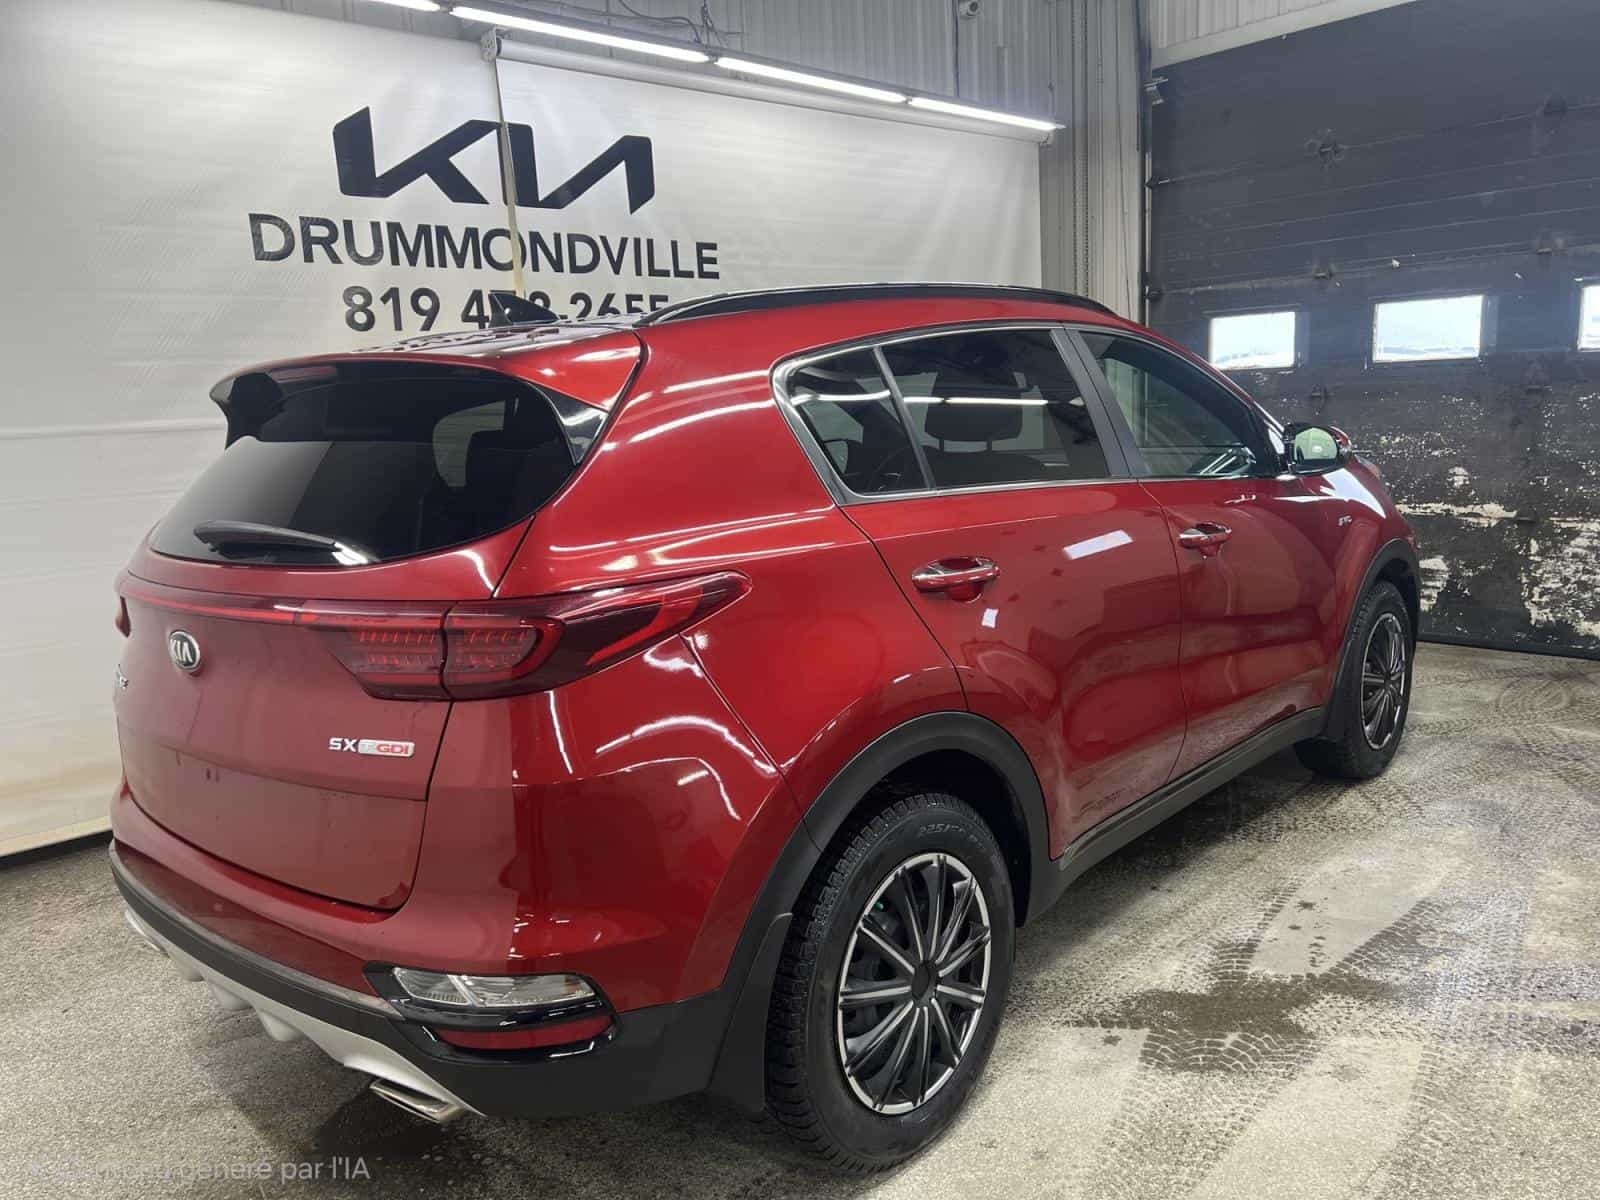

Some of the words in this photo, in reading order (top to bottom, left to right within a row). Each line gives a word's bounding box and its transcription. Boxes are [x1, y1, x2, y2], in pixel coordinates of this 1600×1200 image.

[332, 105, 656, 215] KIA
[248, 212, 721, 280] DRUMMONDVILLE
[343, 284, 441, 332] 819
